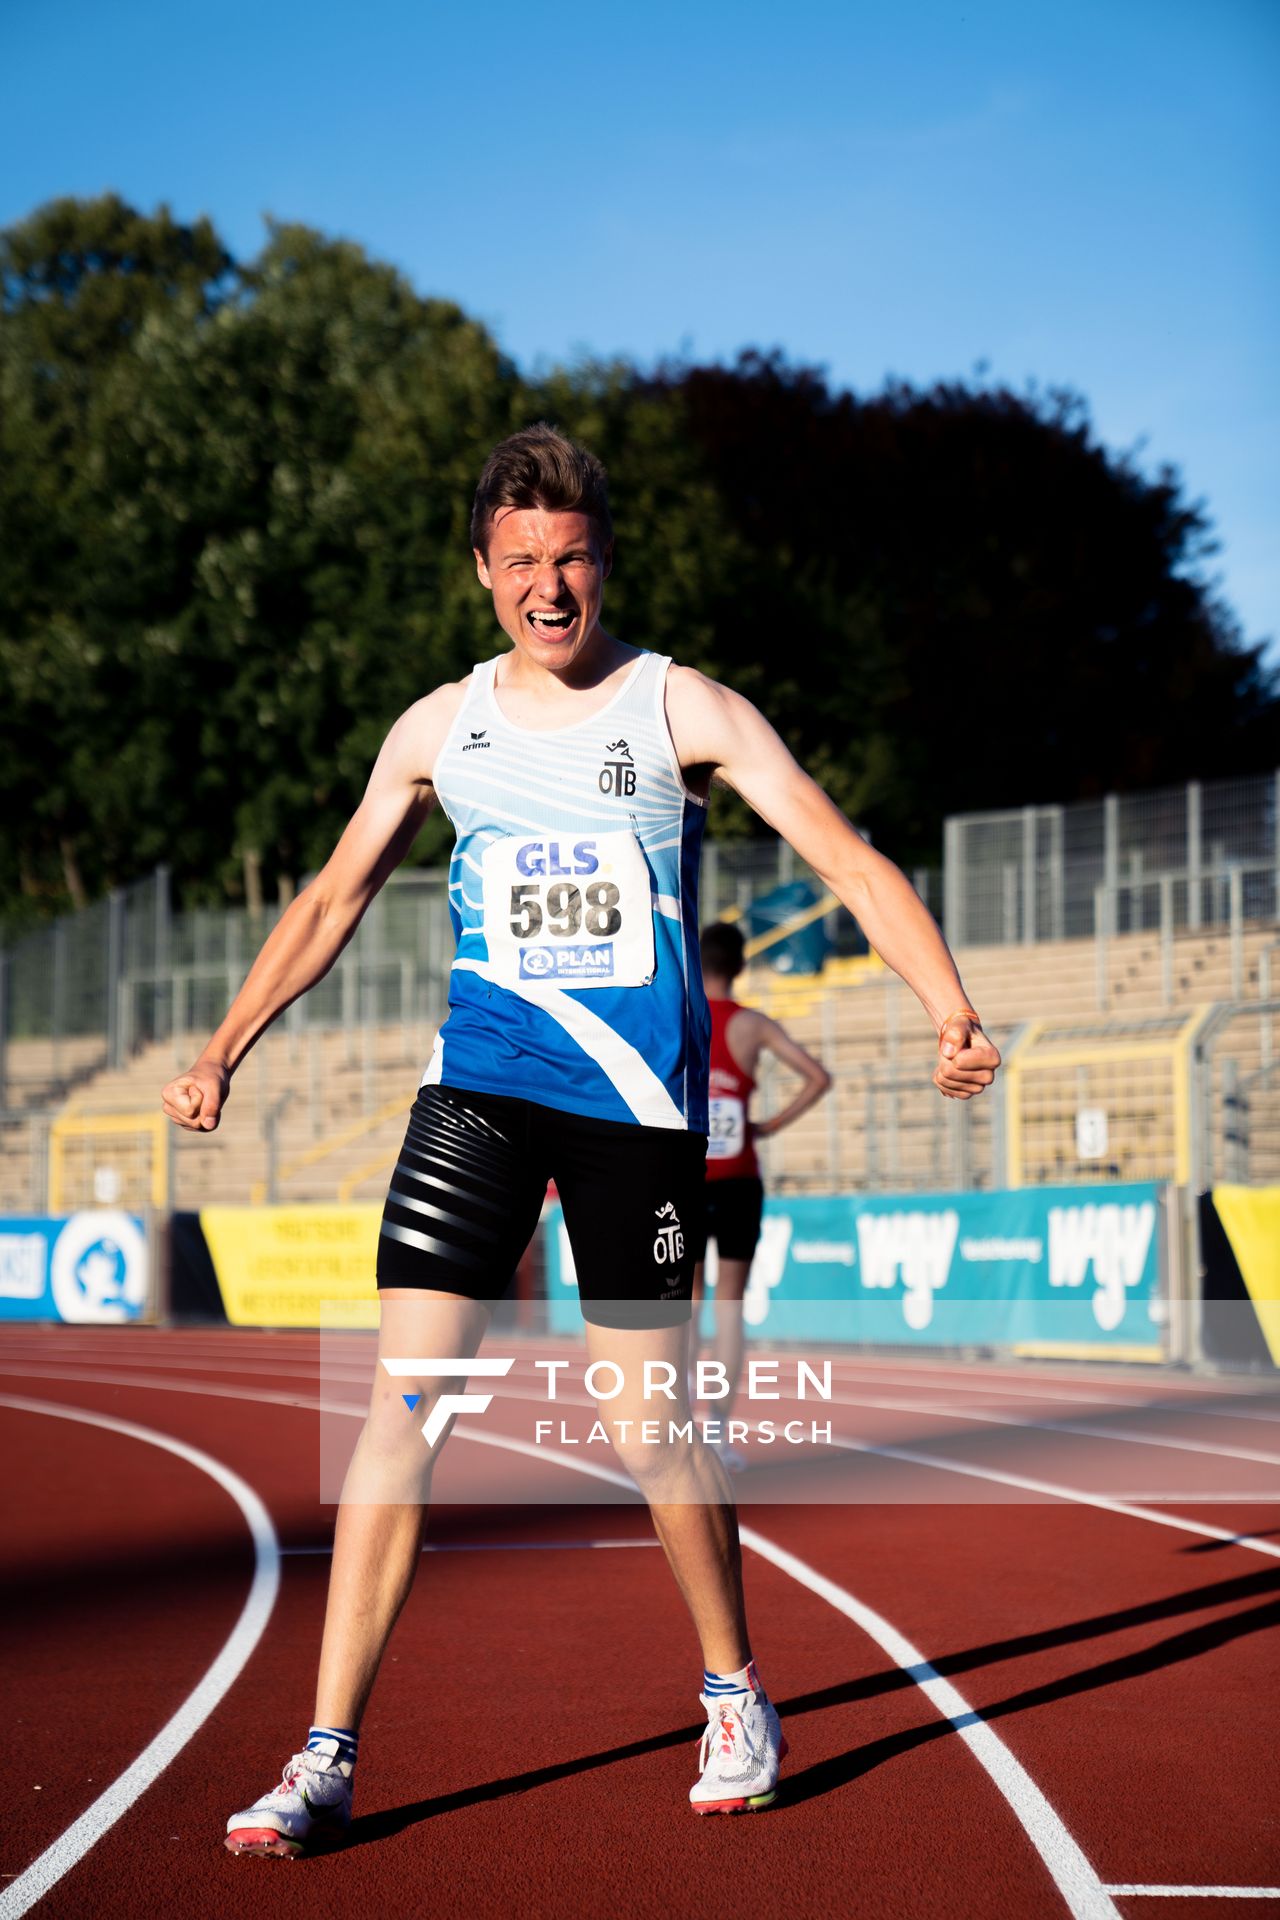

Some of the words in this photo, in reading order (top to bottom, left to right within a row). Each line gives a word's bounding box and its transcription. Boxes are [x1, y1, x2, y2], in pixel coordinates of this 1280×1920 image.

[462, 740, 491, 751] erima
[509, 881, 622, 939] 598
[556, 949, 610, 967] PLAN
